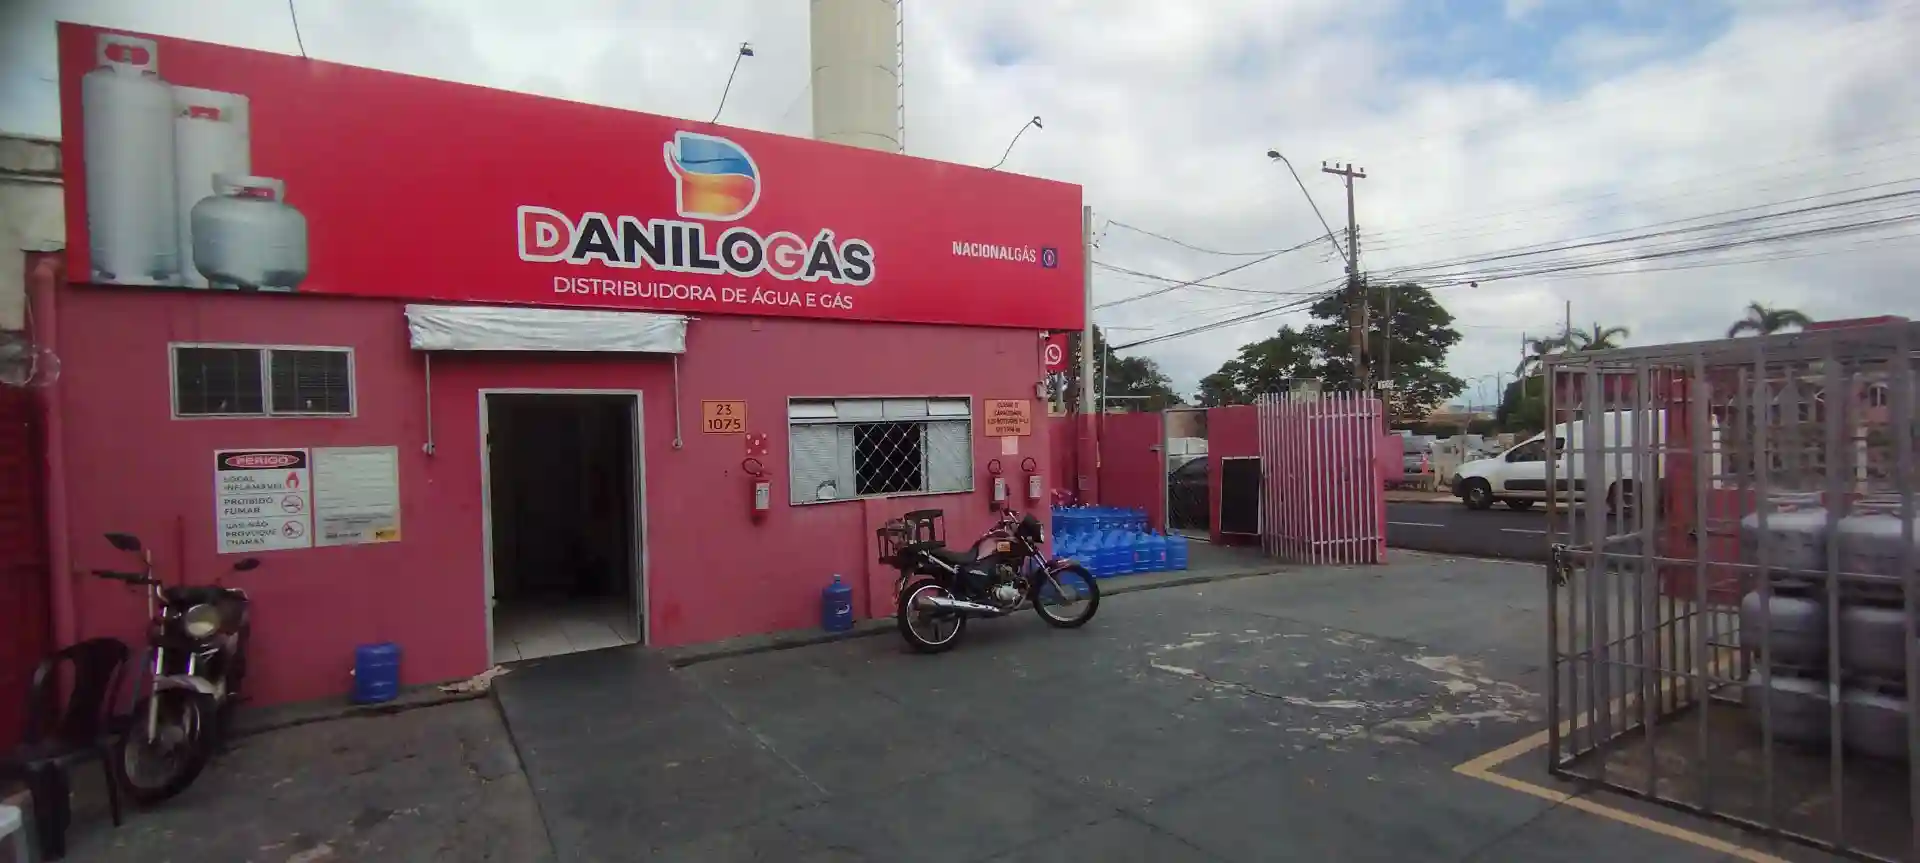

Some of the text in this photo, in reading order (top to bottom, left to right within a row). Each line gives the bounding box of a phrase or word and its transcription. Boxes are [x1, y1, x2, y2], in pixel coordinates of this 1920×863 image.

[518, 205, 874, 285] DANILOGÁS
[952, 241, 1037, 263] NACIONALGÁS
[554, 276, 853, 310] DISTRIBUIDORA DE ÁGUA E GÁS
[716, 404, 732, 416] 23
[708, 419, 741, 430] 1075
[236, 455, 289, 465] PERIGO
